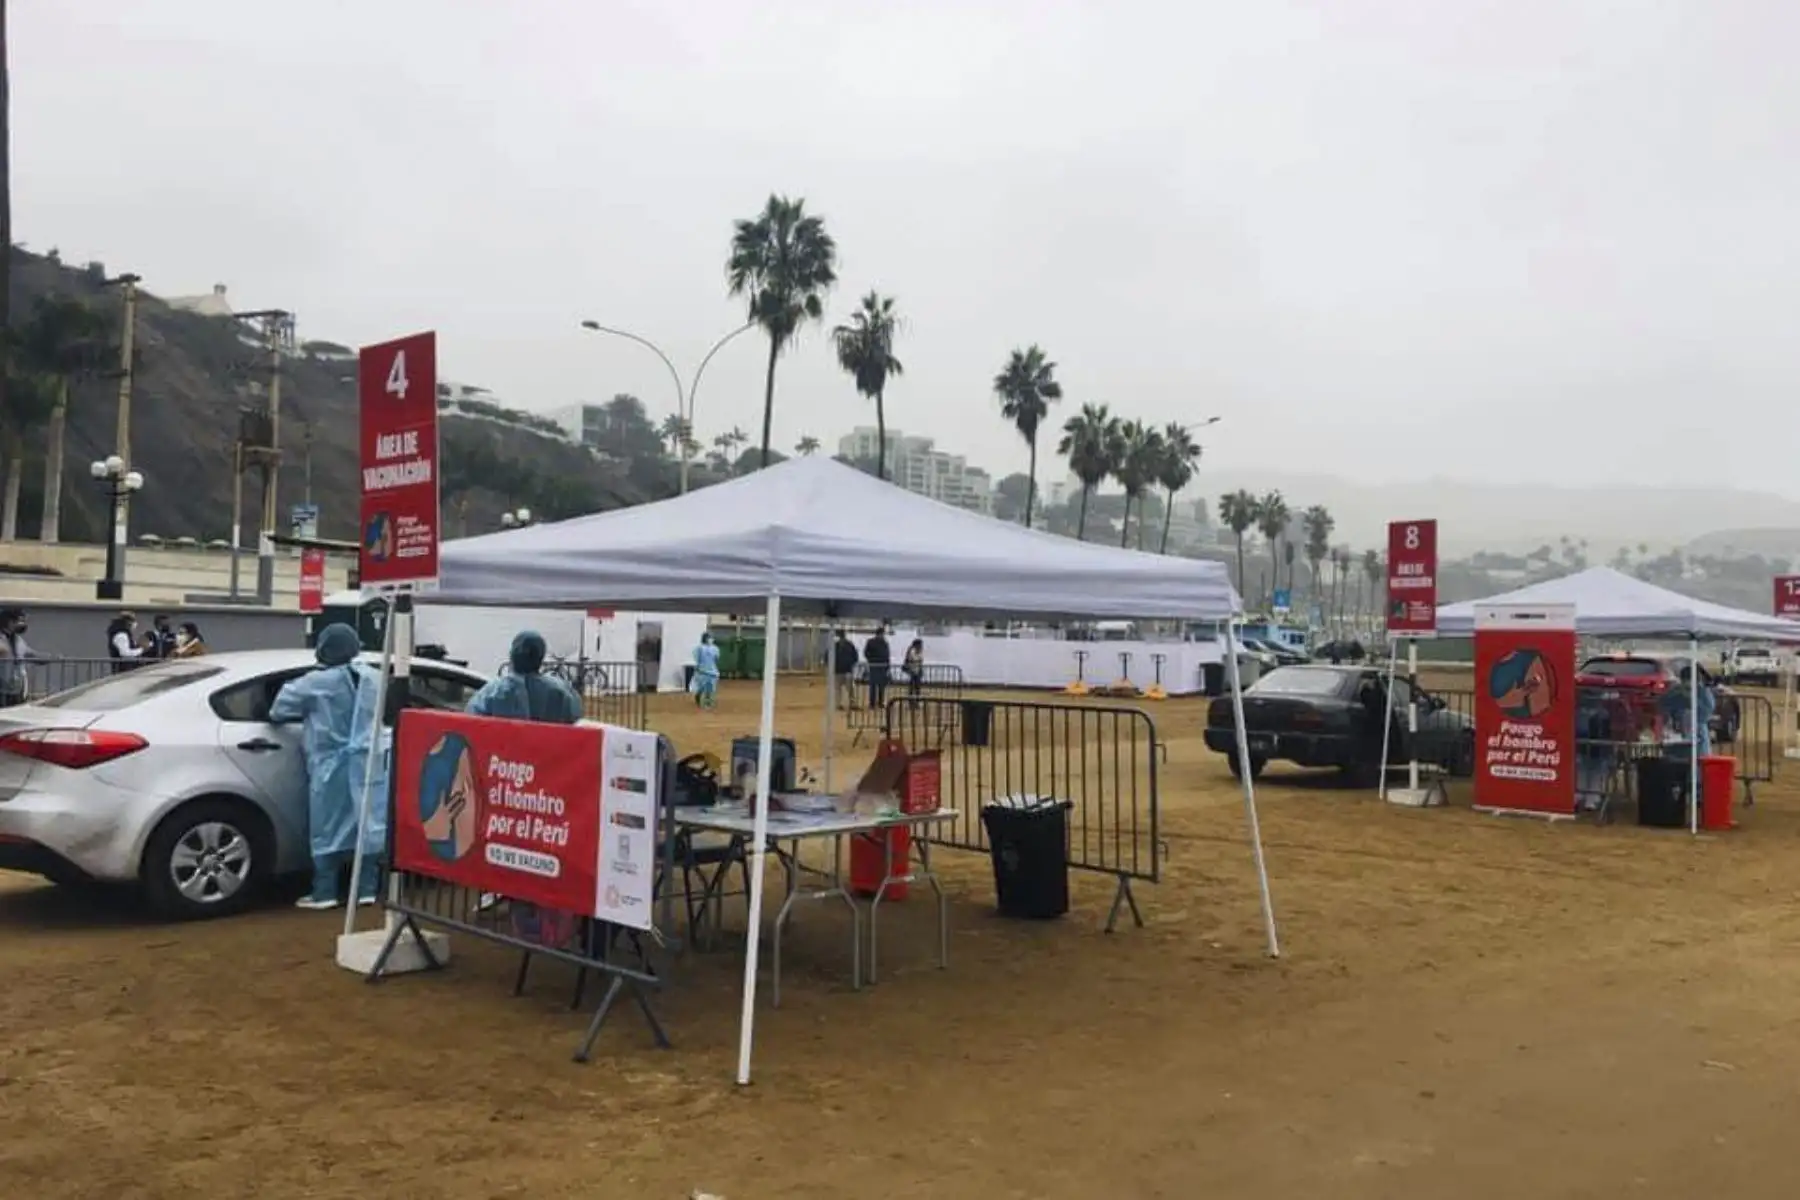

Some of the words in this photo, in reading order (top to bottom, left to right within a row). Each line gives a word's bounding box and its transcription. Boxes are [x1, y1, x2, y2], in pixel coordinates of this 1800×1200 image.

[386, 350, 408, 399] 4
[376, 431, 402, 460] ÁREA
[403, 430, 418, 455] DE
[363, 456, 431, 491] VACUNACIÓN
[1405, 525, 1419, 549] 8
[1488, 734, 1502, 747] el
[1503, 735, 1557, 752] hombro
[1501, 721, 1543, 738] Pongo
[488, 755, 534, 787] Pongo
[1487, 751, 1511, 765] por
[1512, 751, 1526, 762] el
[1528, 751, 1560, 766] Perú
[488, 783, 502, 804] el
[505, 784, 565, 816] hombro
[486, 814, 514, 839] por
[515, 814, 529, 838] el
[532, 818, 570, 846] Perú
